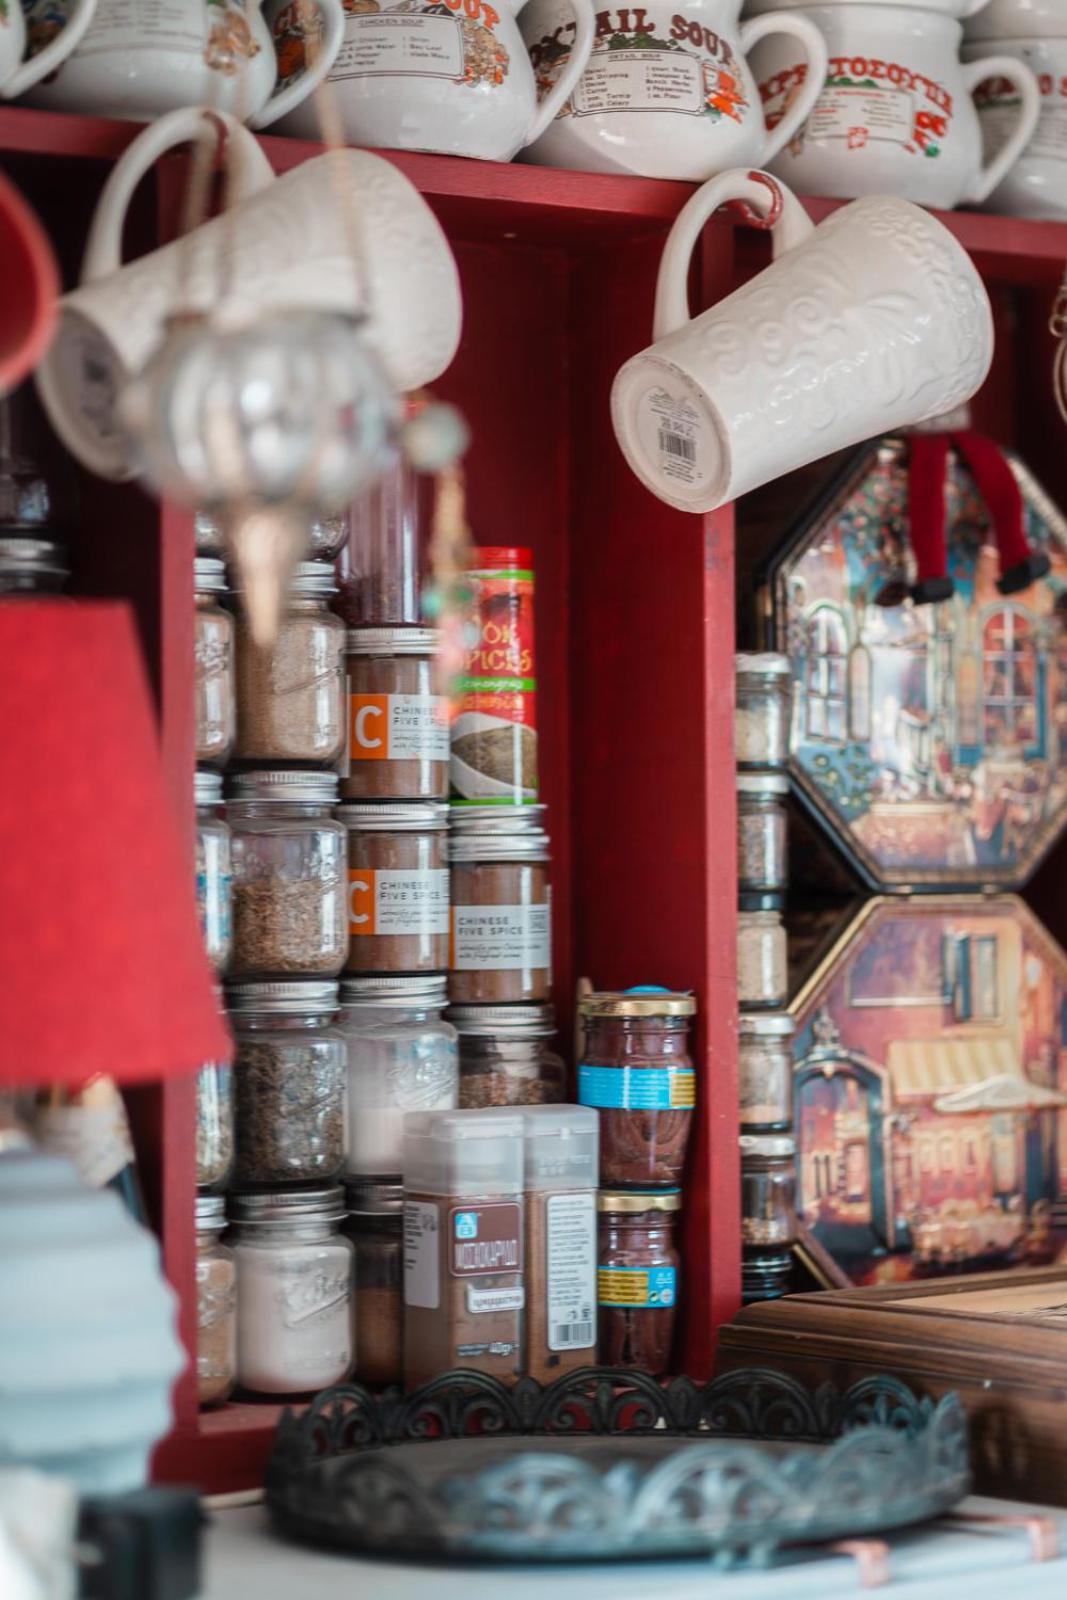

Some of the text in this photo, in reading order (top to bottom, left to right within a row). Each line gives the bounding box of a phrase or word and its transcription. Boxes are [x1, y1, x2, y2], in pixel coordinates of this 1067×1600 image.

[428, 0, 500, 30] UP
[759, 57, 953, 118] ΚΡΕΤΟΣΟΥΠΑ
[460, 649, 532, 672] PICES
[355, 705, 383, 748] C
[393, 717, 419, 726] FIVE
[350, 880, 369, 923] C
[380, 892, 408, 900] FIVE
[458, 916, 509, 926] CHINESE
[458, 926, 523, 936] FIVE SPICE
